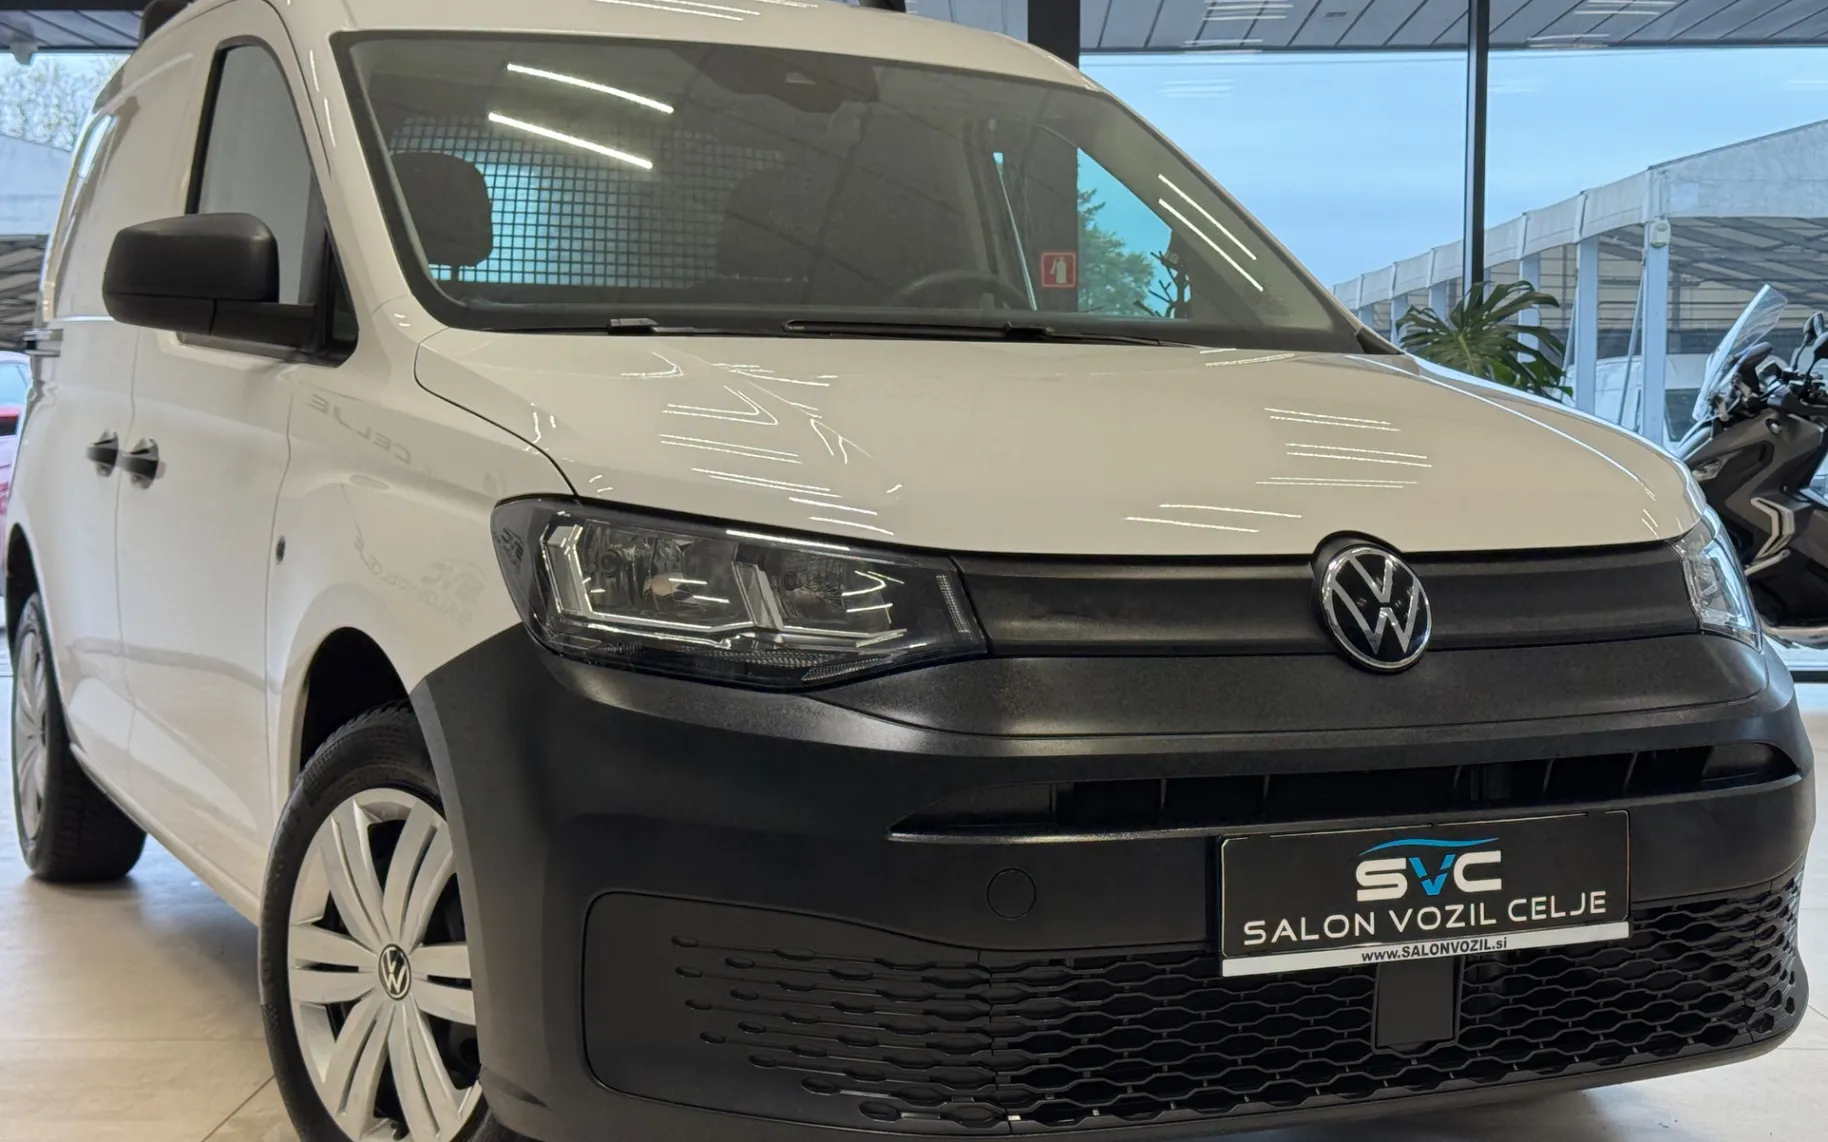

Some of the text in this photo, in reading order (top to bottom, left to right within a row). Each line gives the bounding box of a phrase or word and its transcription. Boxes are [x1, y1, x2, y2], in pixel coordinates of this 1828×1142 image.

[1326, 550, 1423, 657] VW
[1355, 850, 1502, 902] SVC
[1243, 890, 1607, 946] SALON VOZIL CELJE
[1361, 937, 1508, 962] www.SALONVOZIL.si
